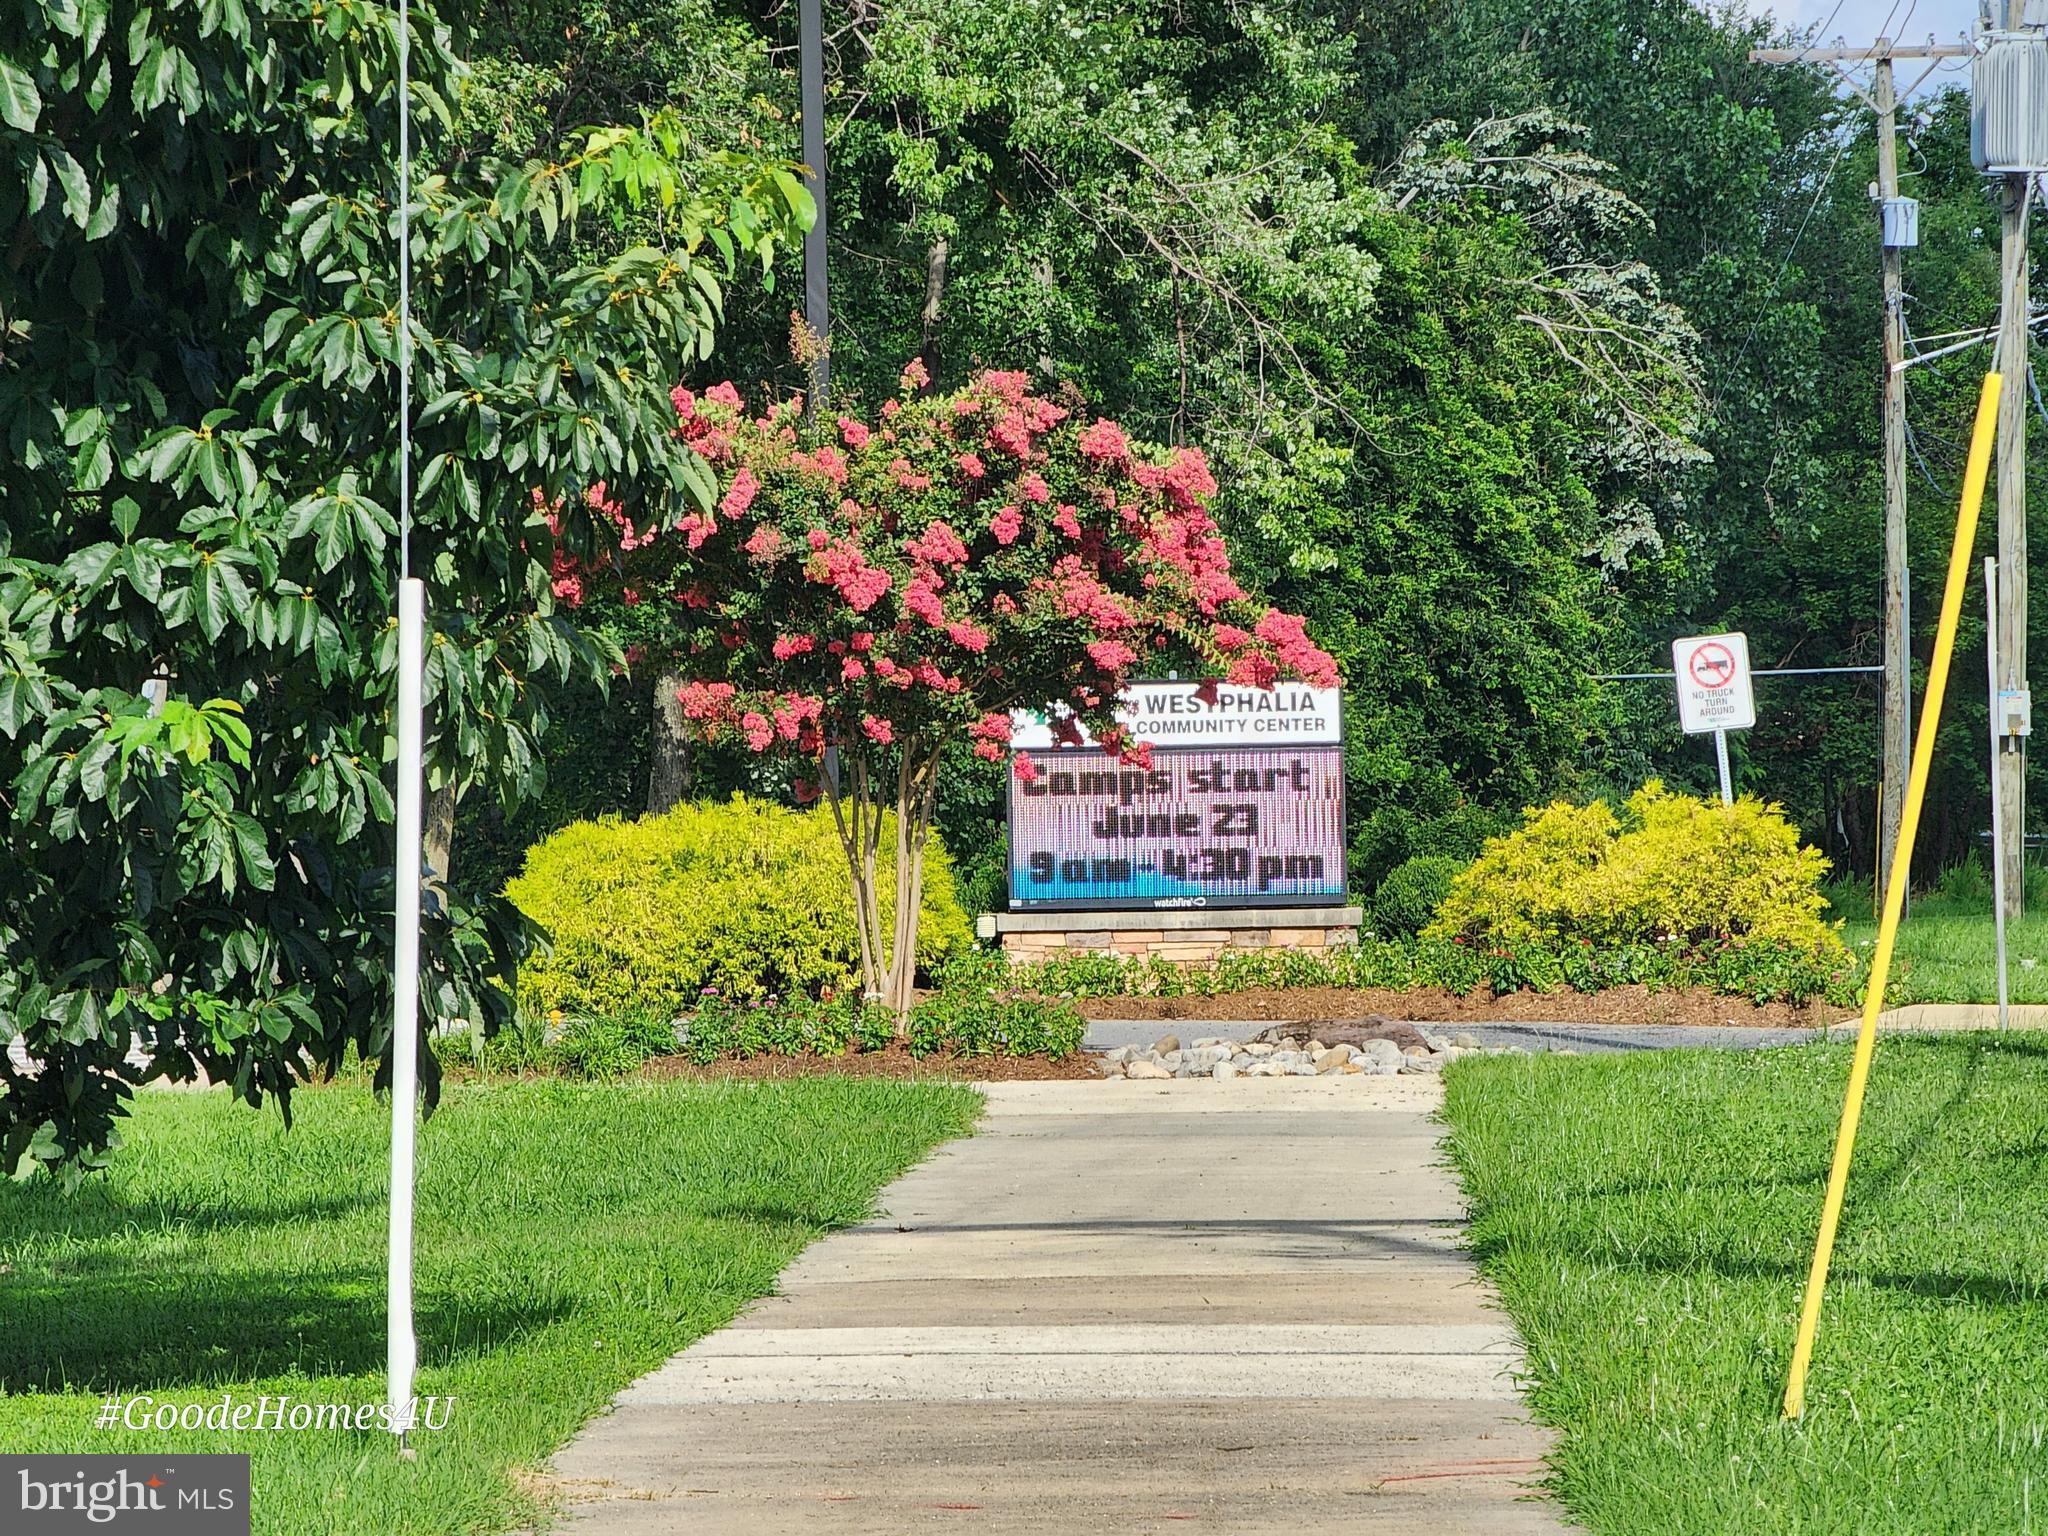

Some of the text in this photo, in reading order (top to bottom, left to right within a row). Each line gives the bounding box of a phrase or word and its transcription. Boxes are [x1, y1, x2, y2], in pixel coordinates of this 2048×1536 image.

[1692, 688, 1735, 699] NO TRUCK
[1704, 698, 1728, 707] TURN
[1700, 706, 1735, 717] AROUND
[1136, 717, 1326, 734] COMMUNITY CENTER
[1187, 759, 1311, 793] start
[1093, 803, 1258, 839] June 23
[1161, 847, 1249, 881] 4:30
[1258, 854, 1324, 891] pm
